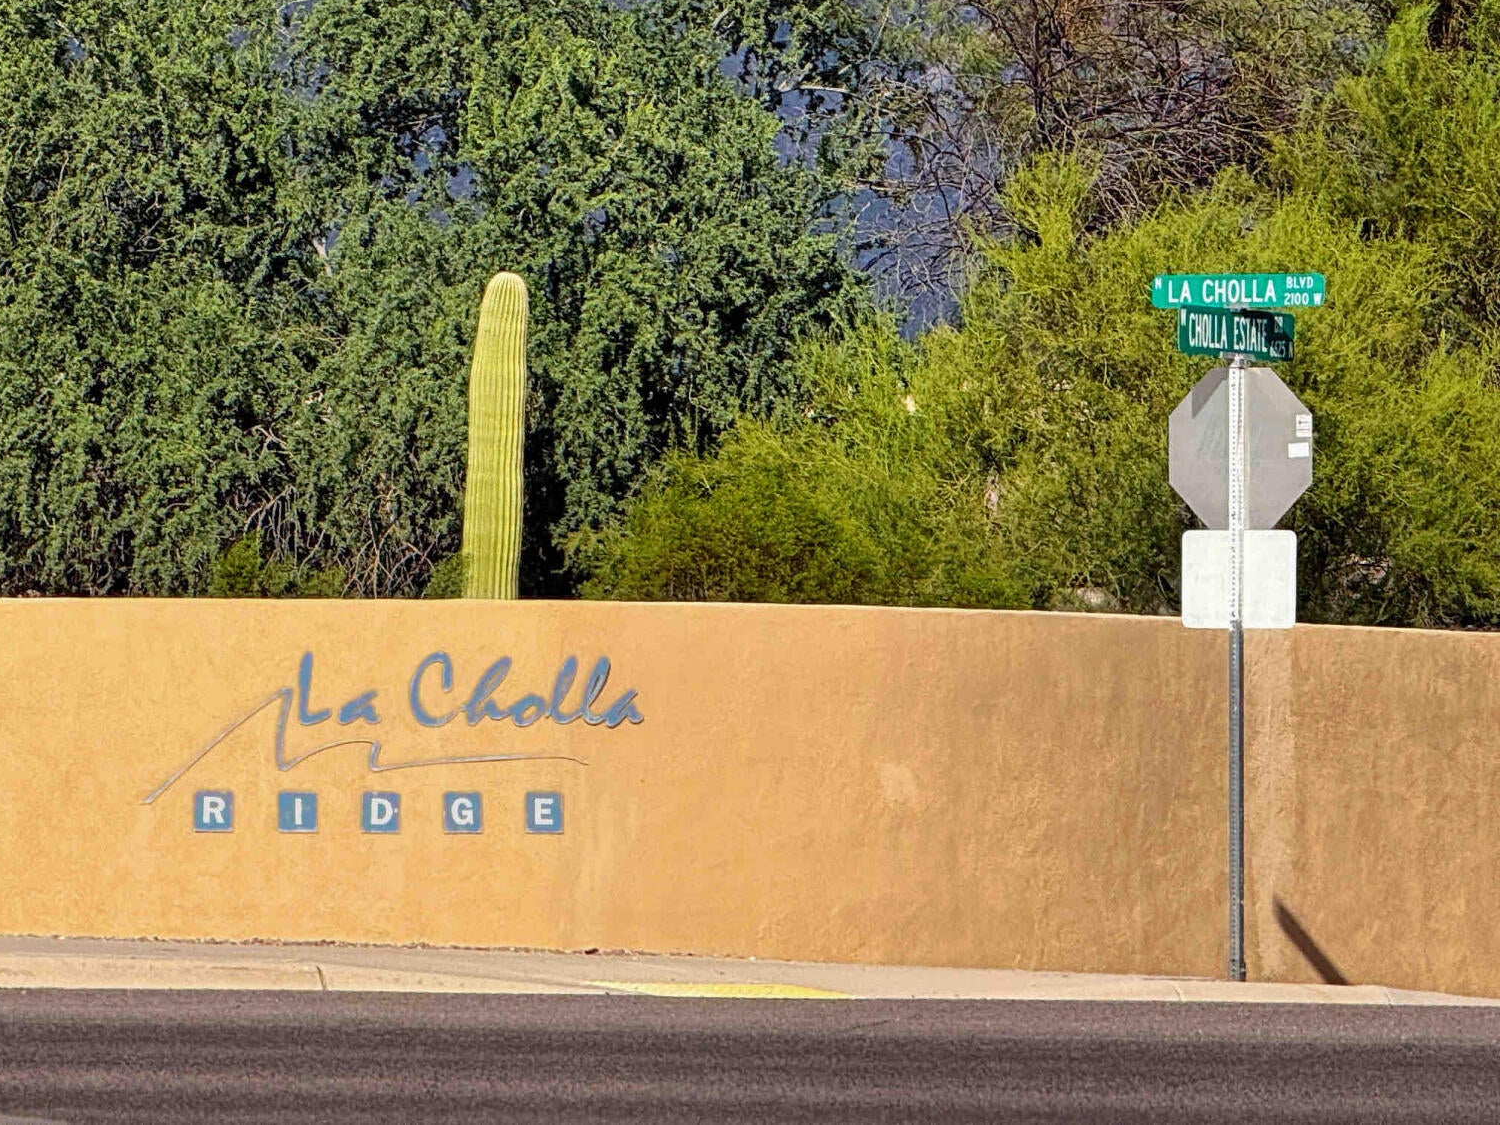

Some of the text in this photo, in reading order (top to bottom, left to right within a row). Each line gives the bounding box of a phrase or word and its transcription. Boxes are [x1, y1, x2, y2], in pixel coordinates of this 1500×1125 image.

[1155, 276, 1314, 303] N LA CHOLLA BLVD
[1283, 293, 1323, 306] 2100 W
[1188, 312, 1228, 349] CHOLLA
[1233, 316, 1268, 353] ESTATE
[299, 651, 645, 728] La Cholla
[200, 795, 556, 827] RIDGE
